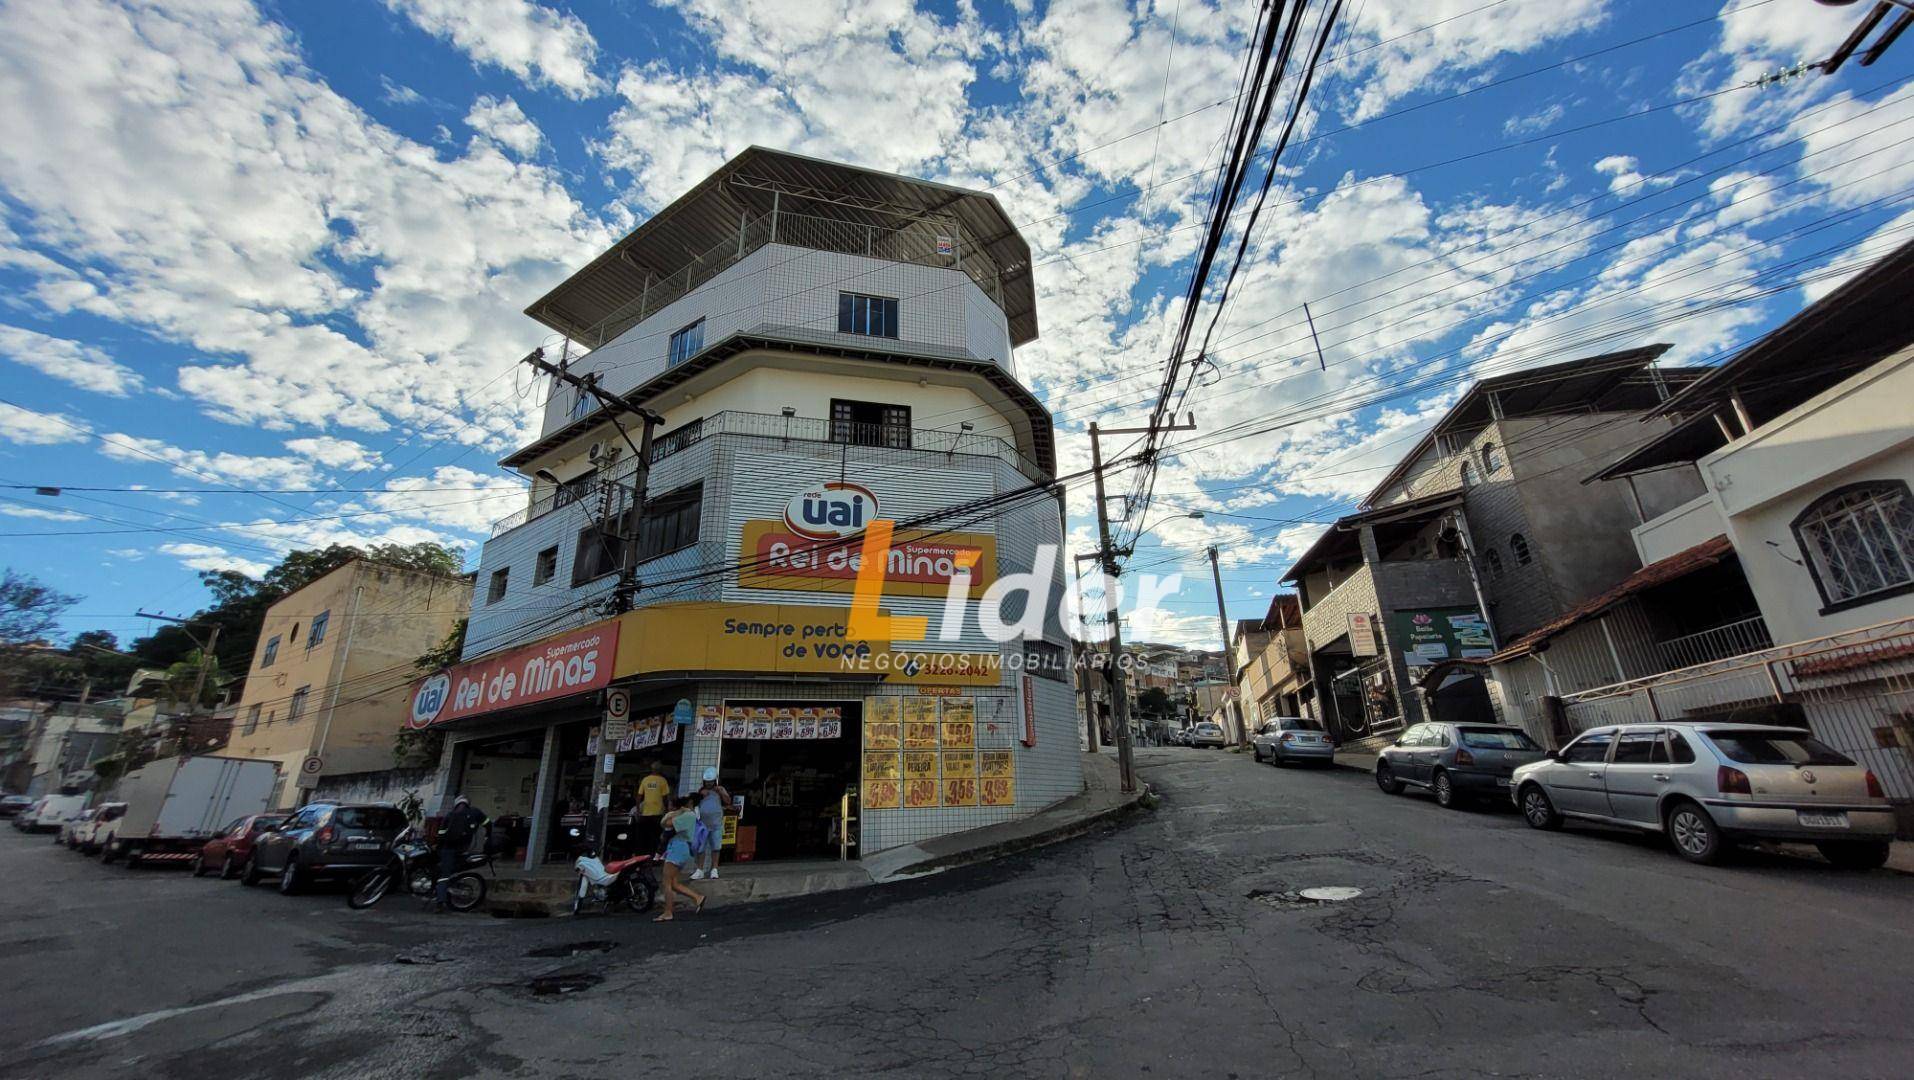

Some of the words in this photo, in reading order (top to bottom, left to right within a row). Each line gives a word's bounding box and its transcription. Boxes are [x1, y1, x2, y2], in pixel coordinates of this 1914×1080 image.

[803, 491, 822, 499] rede
[803, 495, 863, 527] uai
[769, 542, 818, 570] Rei
[827, 546, 869, 572] de
[878, 548, 972, 577] Minas
[725, 618, 795, 637] Sempre
[802, 620, 855, 639] perto
[547, 634, 600, 659] Supermercado
[783, 643, 807, 658] de
[453, 673, 486, 712] Rei
[488, 667, 516, 704] de
[521, 650, 598, 696] Minas
[615, 698, 622, 711] E
[308, 761, 318, 770] E
